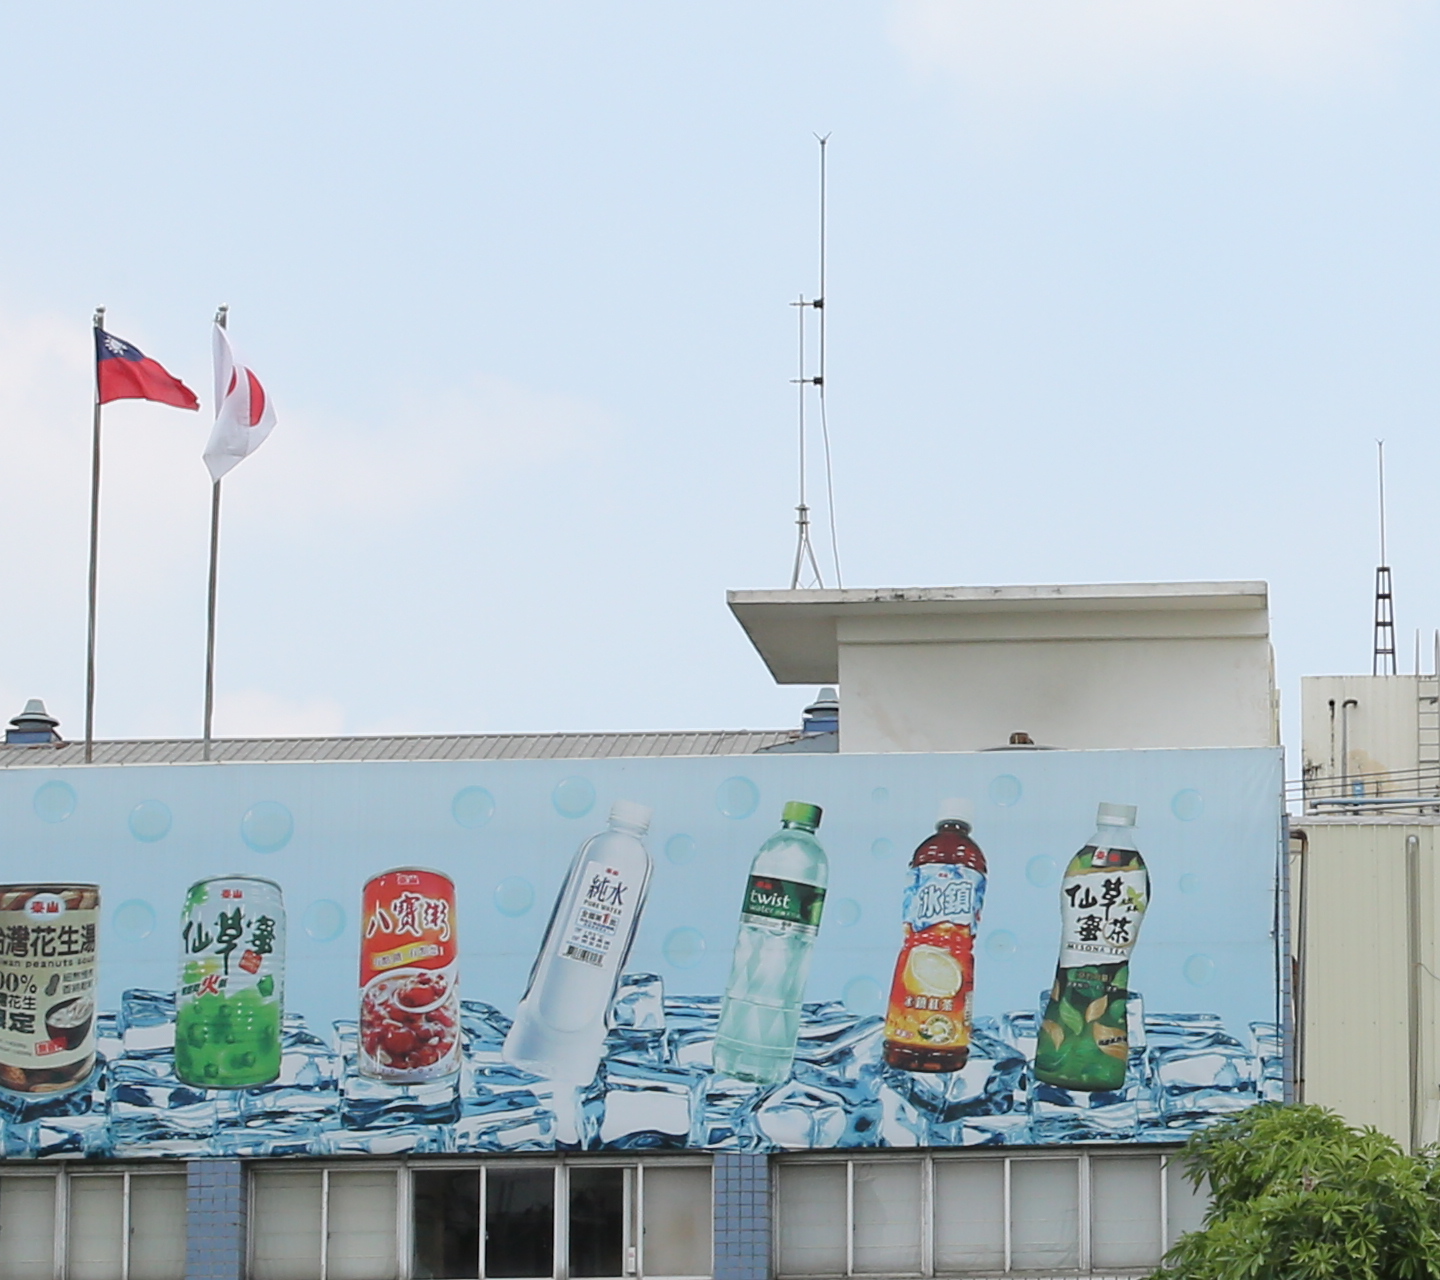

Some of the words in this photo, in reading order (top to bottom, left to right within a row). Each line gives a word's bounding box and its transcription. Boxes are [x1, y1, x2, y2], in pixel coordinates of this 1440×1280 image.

[587, 874, 628, 906] 純水
[31, 900, 59, 913] 泰山
[751, 889, 790, 909] twist
[25, 959, 73, 968] peanuts
